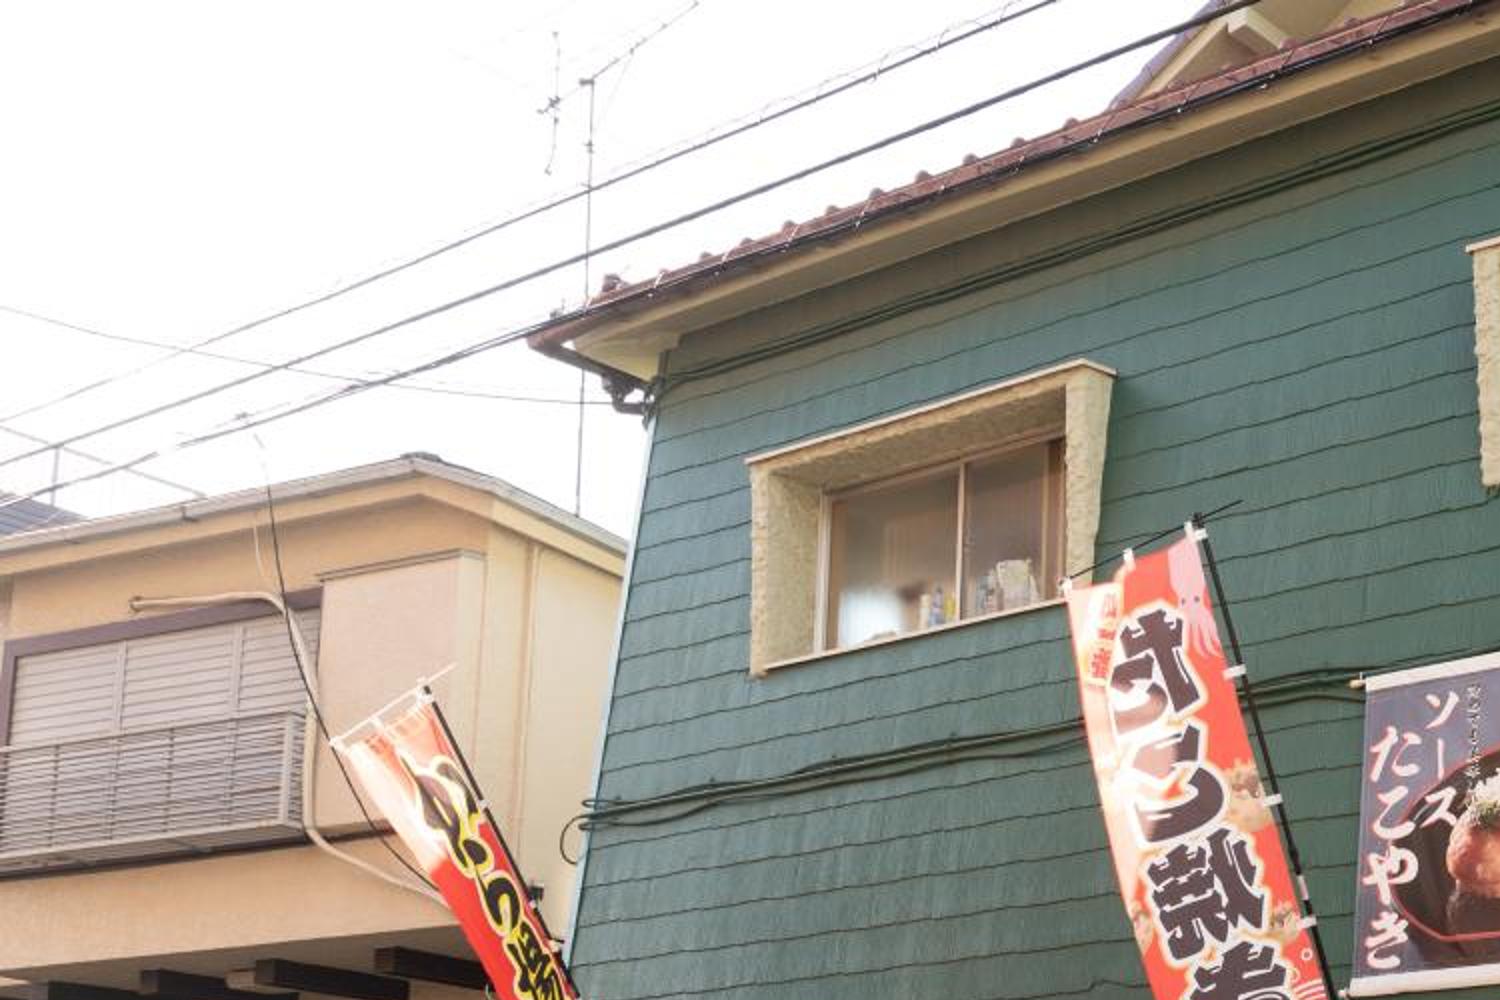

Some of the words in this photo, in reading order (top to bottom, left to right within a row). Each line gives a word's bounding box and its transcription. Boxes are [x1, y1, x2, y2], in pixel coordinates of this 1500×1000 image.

[1363, 725, 1422, 969] たこやき
[1424, 690, 1460, 828] ソース
